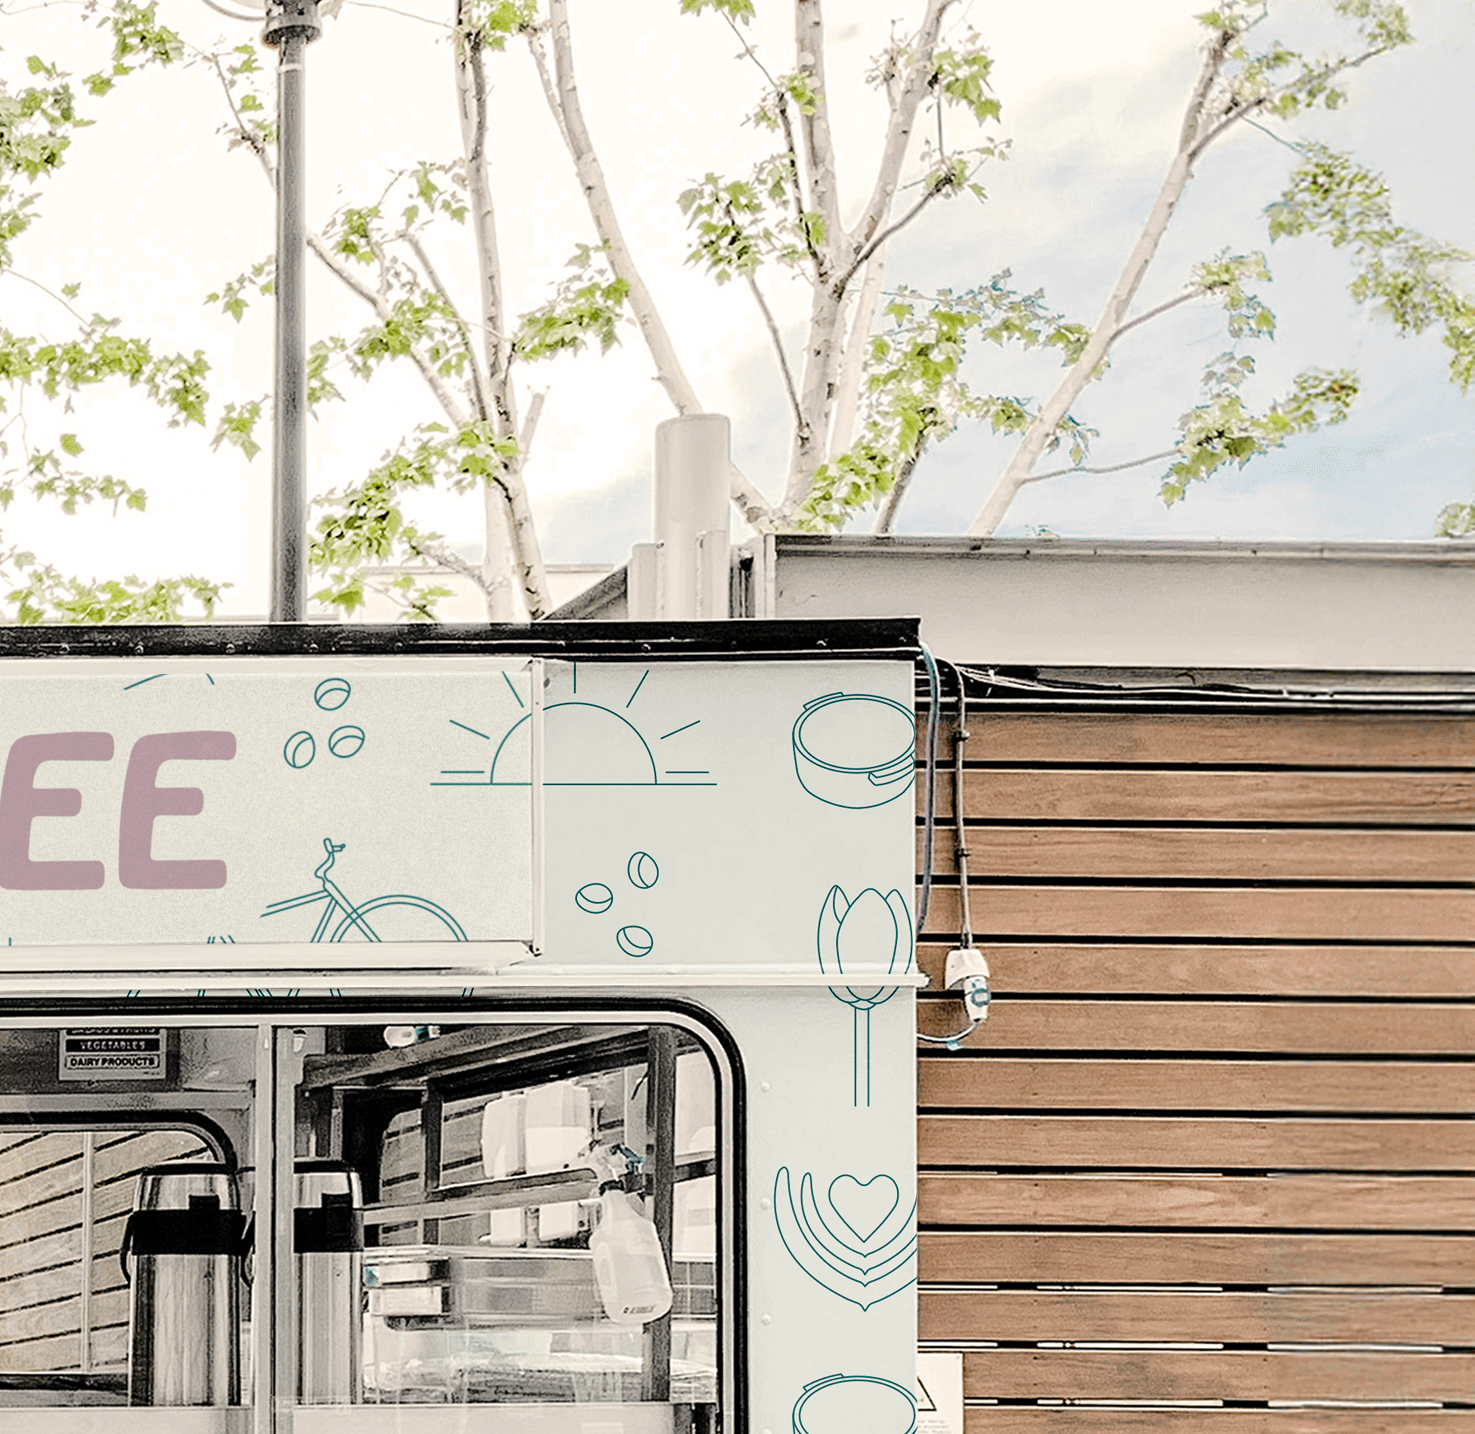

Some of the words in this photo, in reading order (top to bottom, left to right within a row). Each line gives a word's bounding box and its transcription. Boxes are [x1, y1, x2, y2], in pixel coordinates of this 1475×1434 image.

[80, 1041, 146, 1050] VEGETABLES
[70, 1057, 100, 1067] DAIRY
[101, 1057, 155, 1067] PRODUCTS
